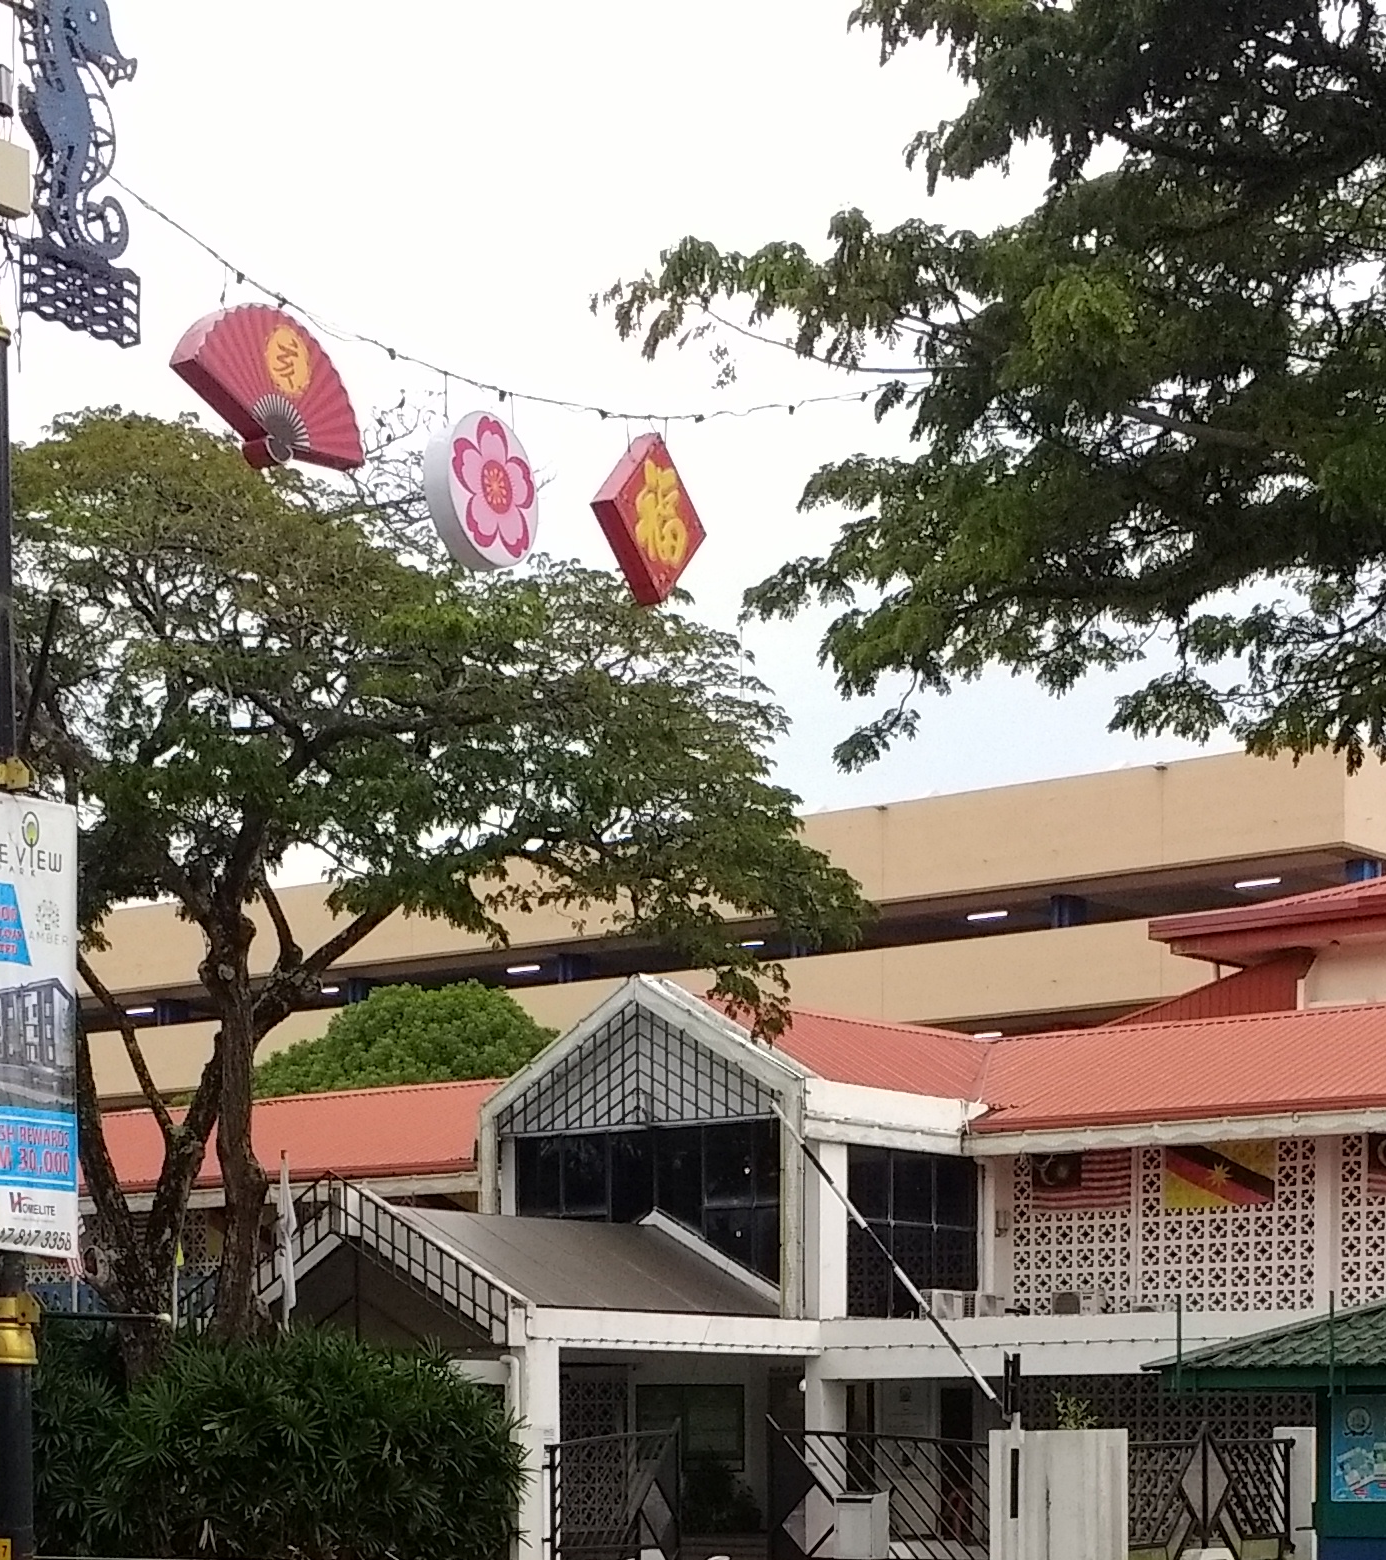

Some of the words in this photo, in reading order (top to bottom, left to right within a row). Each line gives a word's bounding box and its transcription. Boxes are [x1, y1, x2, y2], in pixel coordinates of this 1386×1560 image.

[634, 459, 690, 567] 福
[15, 843, 62, 873] VIEW
[29, 931, 69, 946] AMBER
[19, 1125, 69, 1149] REWARDS
[19, 1147, 69, 1176] 30,000
[9, 1192, 56, 1216] HOMELITE
[14, 1227, 41, 1246] 817
[41, 1230, 72, 1251] 3358
